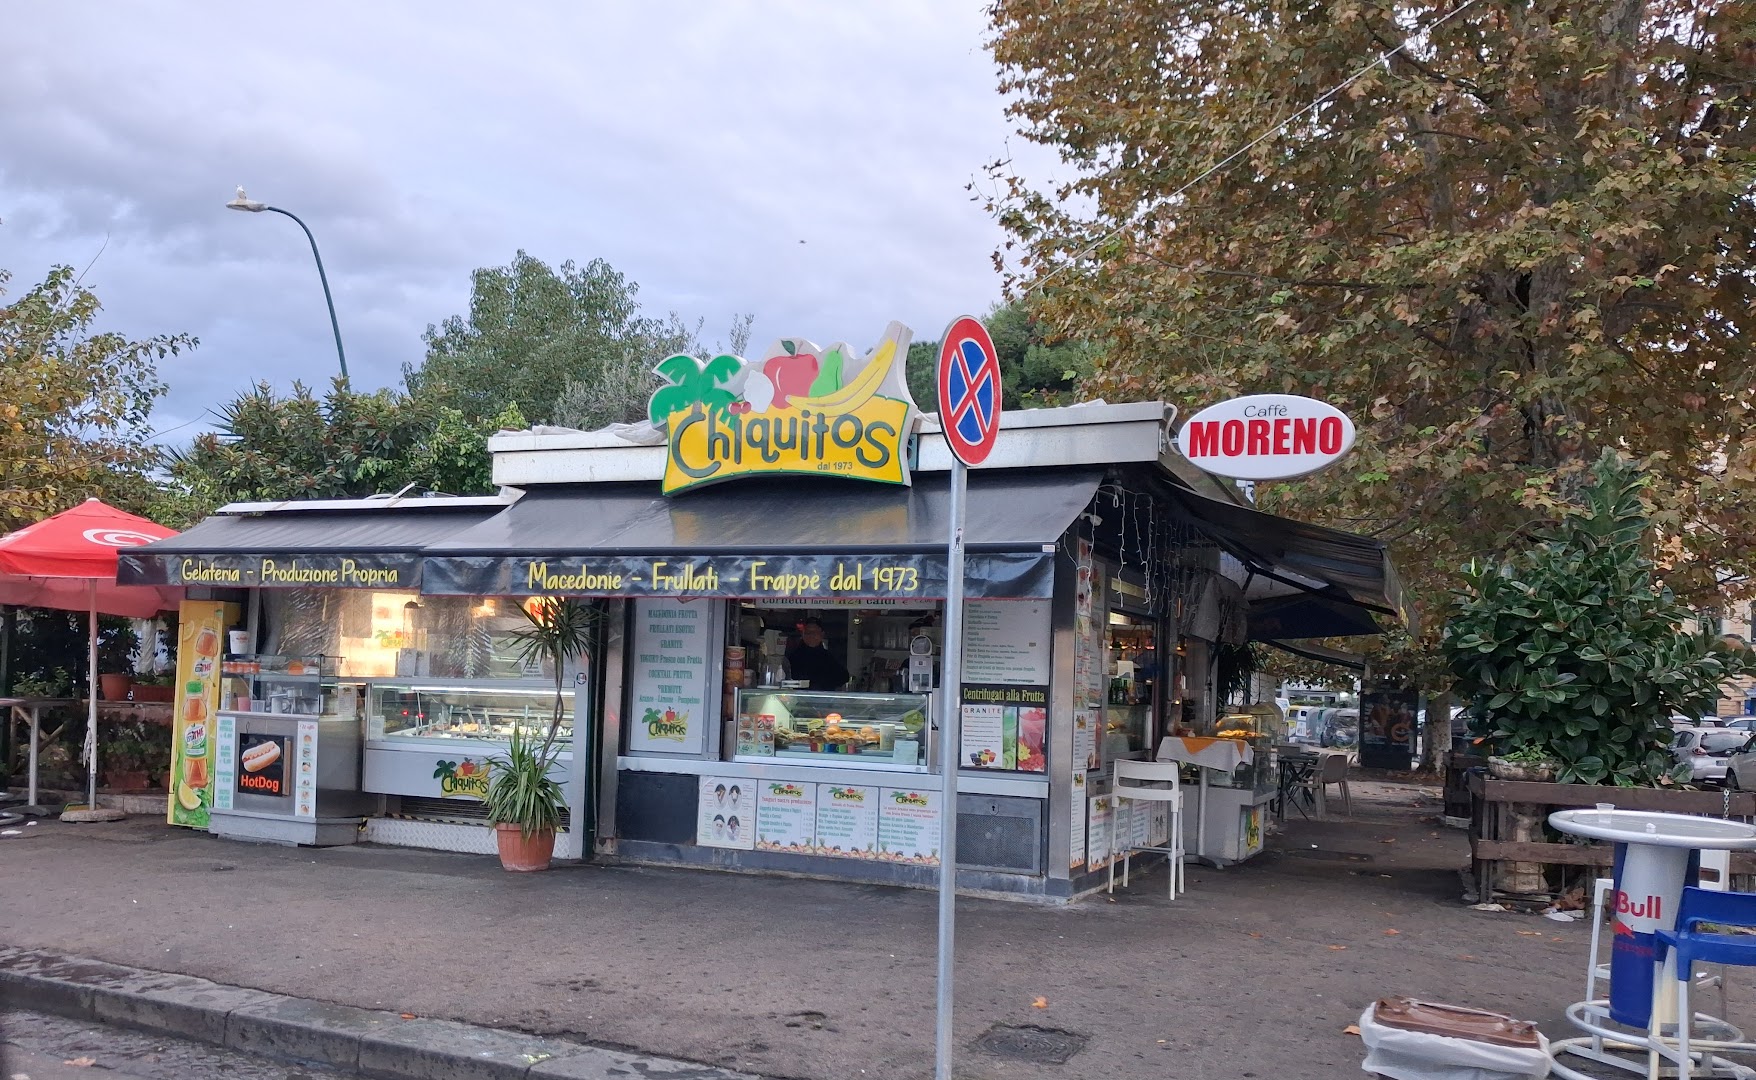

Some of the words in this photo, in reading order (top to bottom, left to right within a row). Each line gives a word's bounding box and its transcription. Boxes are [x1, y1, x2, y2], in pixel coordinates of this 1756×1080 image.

[1244, 404, 1288, 418] Caffè
[672, 409, 897, 478] Chiquitos
[1189, 416, 1343, 458] MORENO
[817, 461, 831, 471] dal
[833, 461, 853, 471] 1973
[181, 558, 240, 582] Gelateria
[261, 558, 338, 583] Produzione
[341, 558, 398, 586] Propria
[528, 561, 622, 590] Macedonie
[652, 561, 719, 591] Frullati
[751, 561, 821, 595] Frappè
[829, 563, 862, 591] dal
[872, 567, 919, 591] 1973
[661, 640, 682, 648] GRANITE
[963, 687, 1005, 703] Centrifugati
[1006, 688, 1020, 702] alla
[1022, 689, 1045, 703] Frutta
[240, 774, 279, 793] HotDog
[441, 775, 489, 794] Chiquitos
[1614, 889, 1662, 920] Bull
